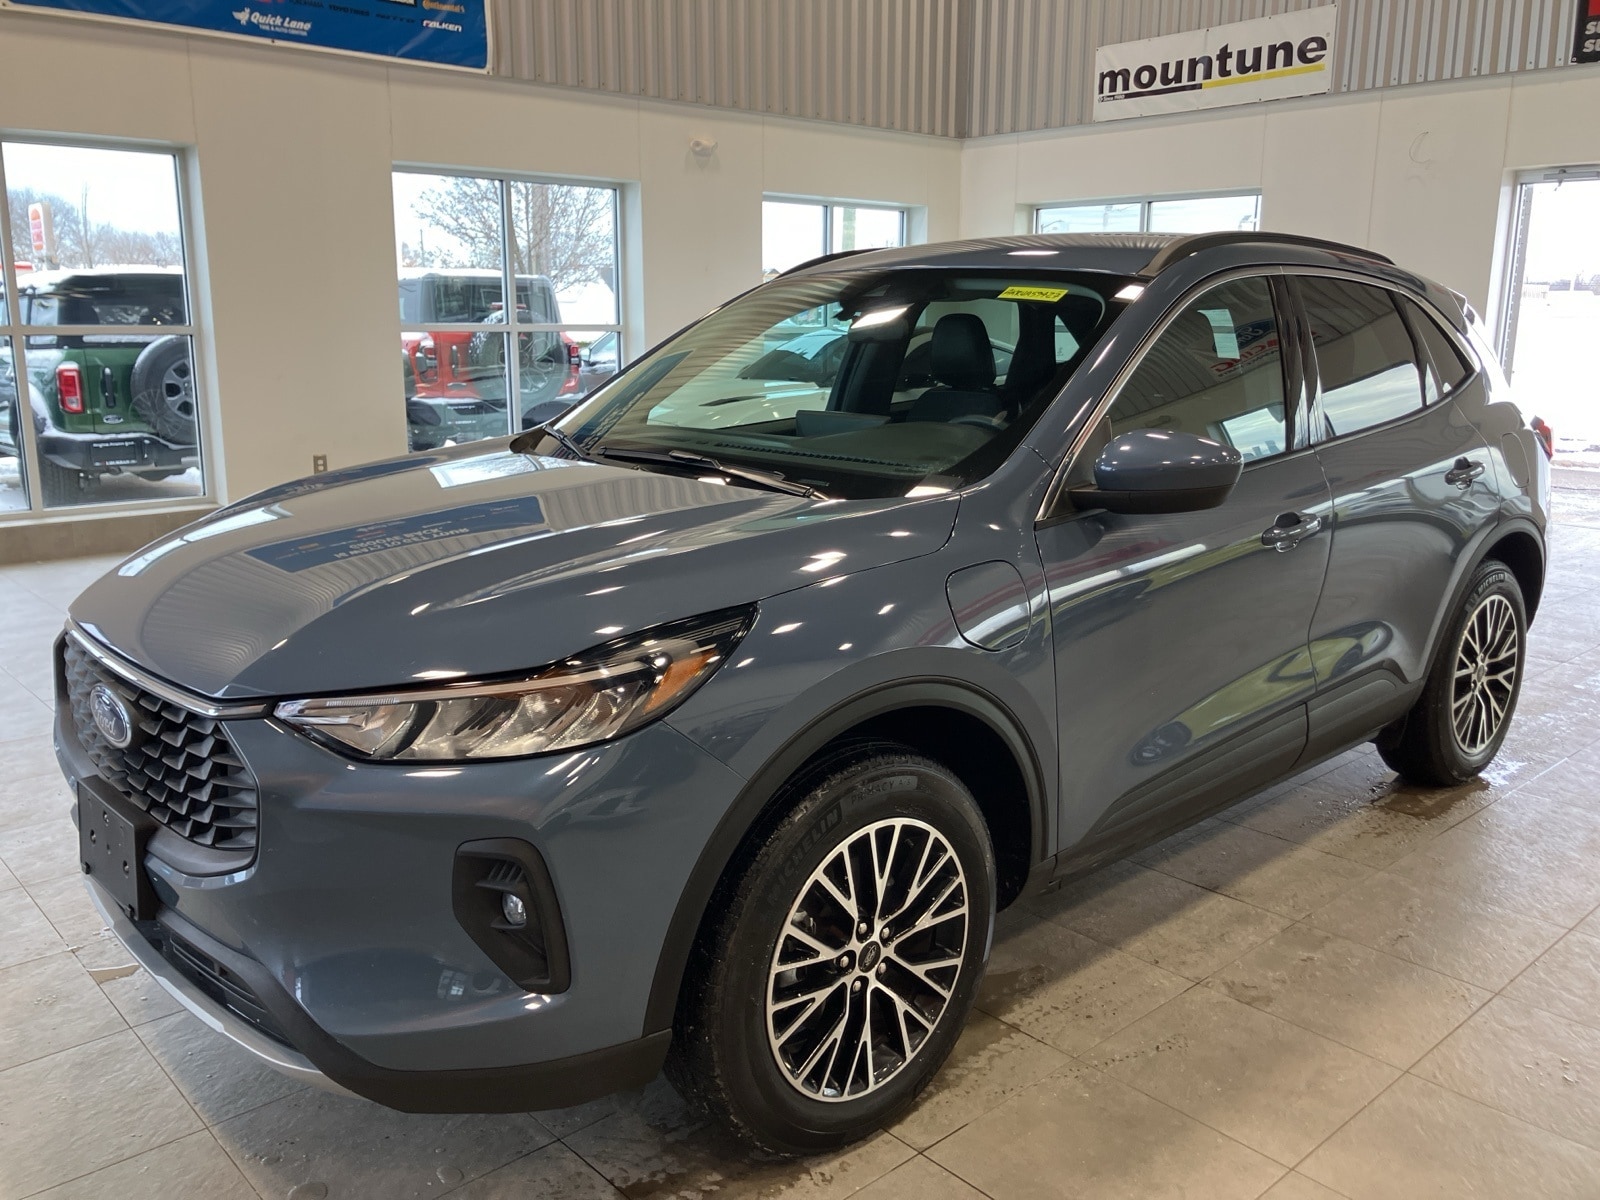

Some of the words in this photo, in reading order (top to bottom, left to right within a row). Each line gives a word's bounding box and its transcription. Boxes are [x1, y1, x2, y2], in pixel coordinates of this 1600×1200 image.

[250, 11, 283, 25] Quick
[283, 17, 313, 30] Lane
[422, 19, 462, 32] FALKEN
[1098, 36, 1328, 95] mountune
